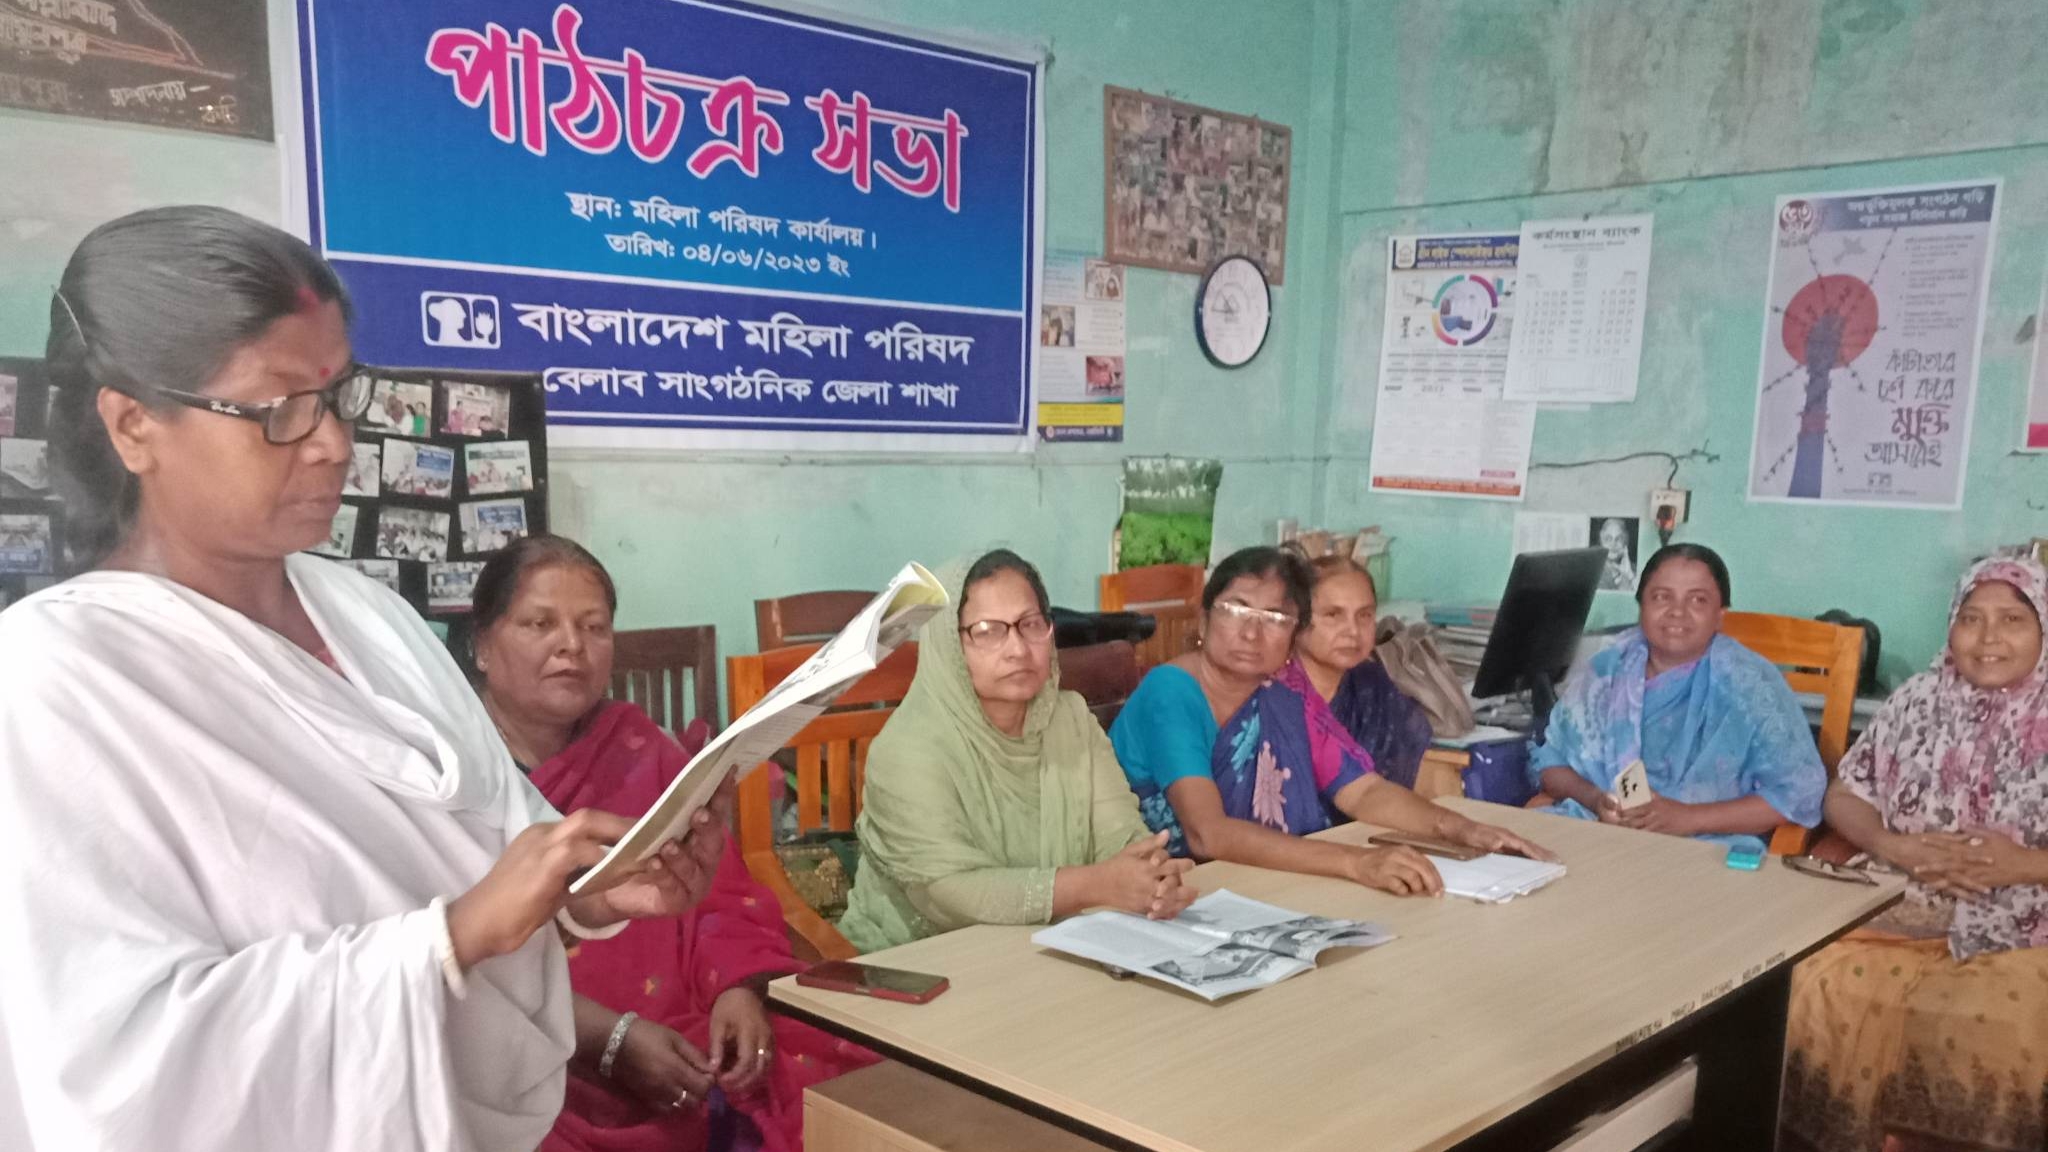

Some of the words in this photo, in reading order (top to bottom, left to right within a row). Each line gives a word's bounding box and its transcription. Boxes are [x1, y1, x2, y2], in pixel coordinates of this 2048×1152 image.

[425, 2, 790, 180] পাঠচক্র
[804, 88, 969, 213] সভা
[629, 196, 700, 229] মহিলা
[708, 205, 780, 238] পরিষদ
[787, 217, 864, 248] কার্যালয়
[682, 243, 822, 273] ০৪/০৬/২০২৩
[827, 252, 850, 278] ইং
[510, 302, 731, 351] বাংলাদেশ
[738, 311, 854, 359] মহিলা
[864, 321, 976, 365] পরিষদ
[542, 366, 649, 397] বেলাব
[654, 365, 814, 402] সাংগঠনিক
[822, 379, 893, 406] জেলা
[898, 381, 960, 408] শাখা
